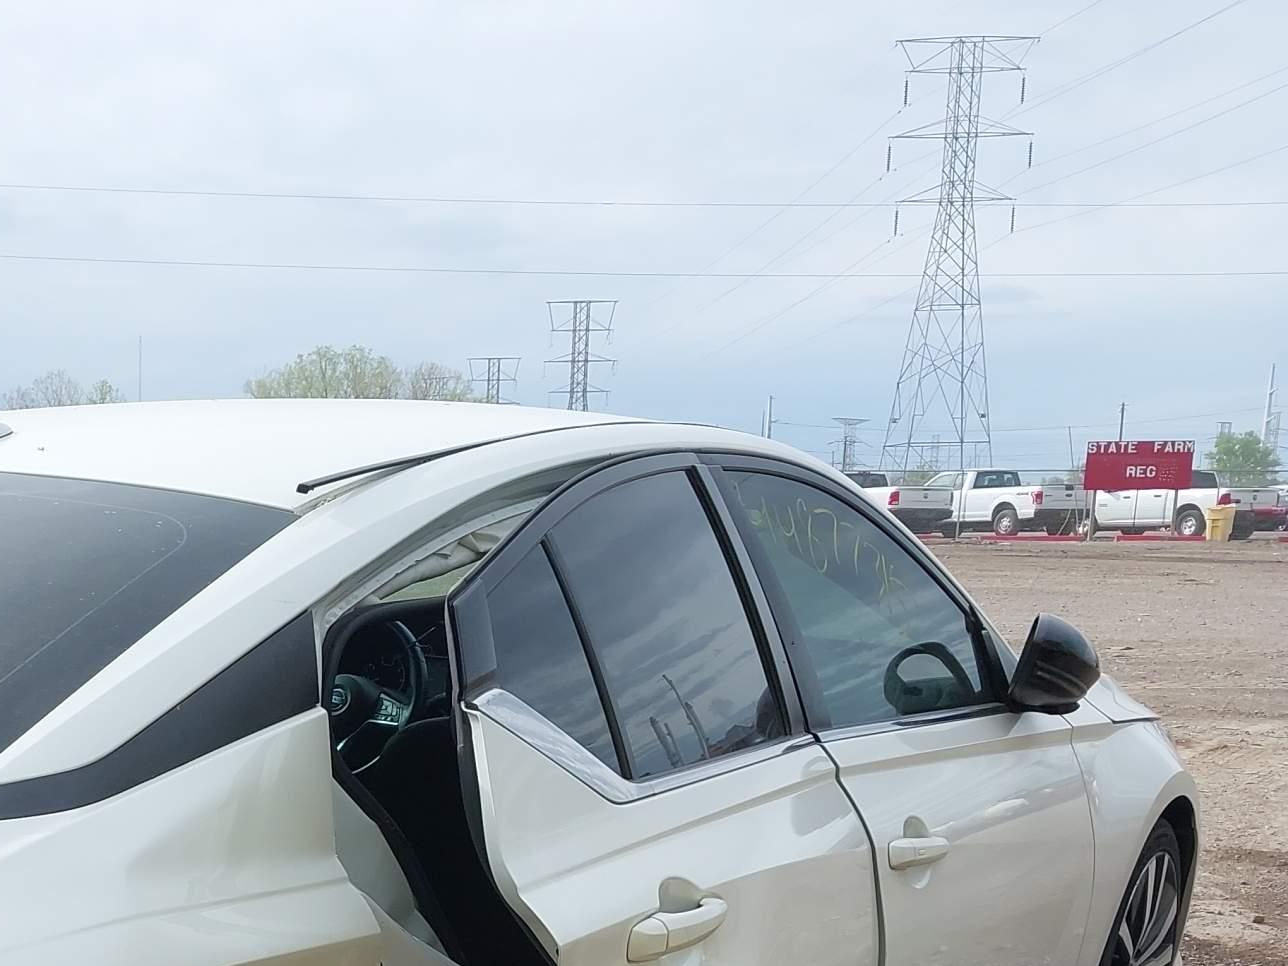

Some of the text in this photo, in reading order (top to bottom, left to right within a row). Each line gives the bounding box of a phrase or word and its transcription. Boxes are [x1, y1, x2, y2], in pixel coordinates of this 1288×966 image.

[1087, 441, 1194, 453] STATE FARM
[1125, 465, 1157, 478] REG
